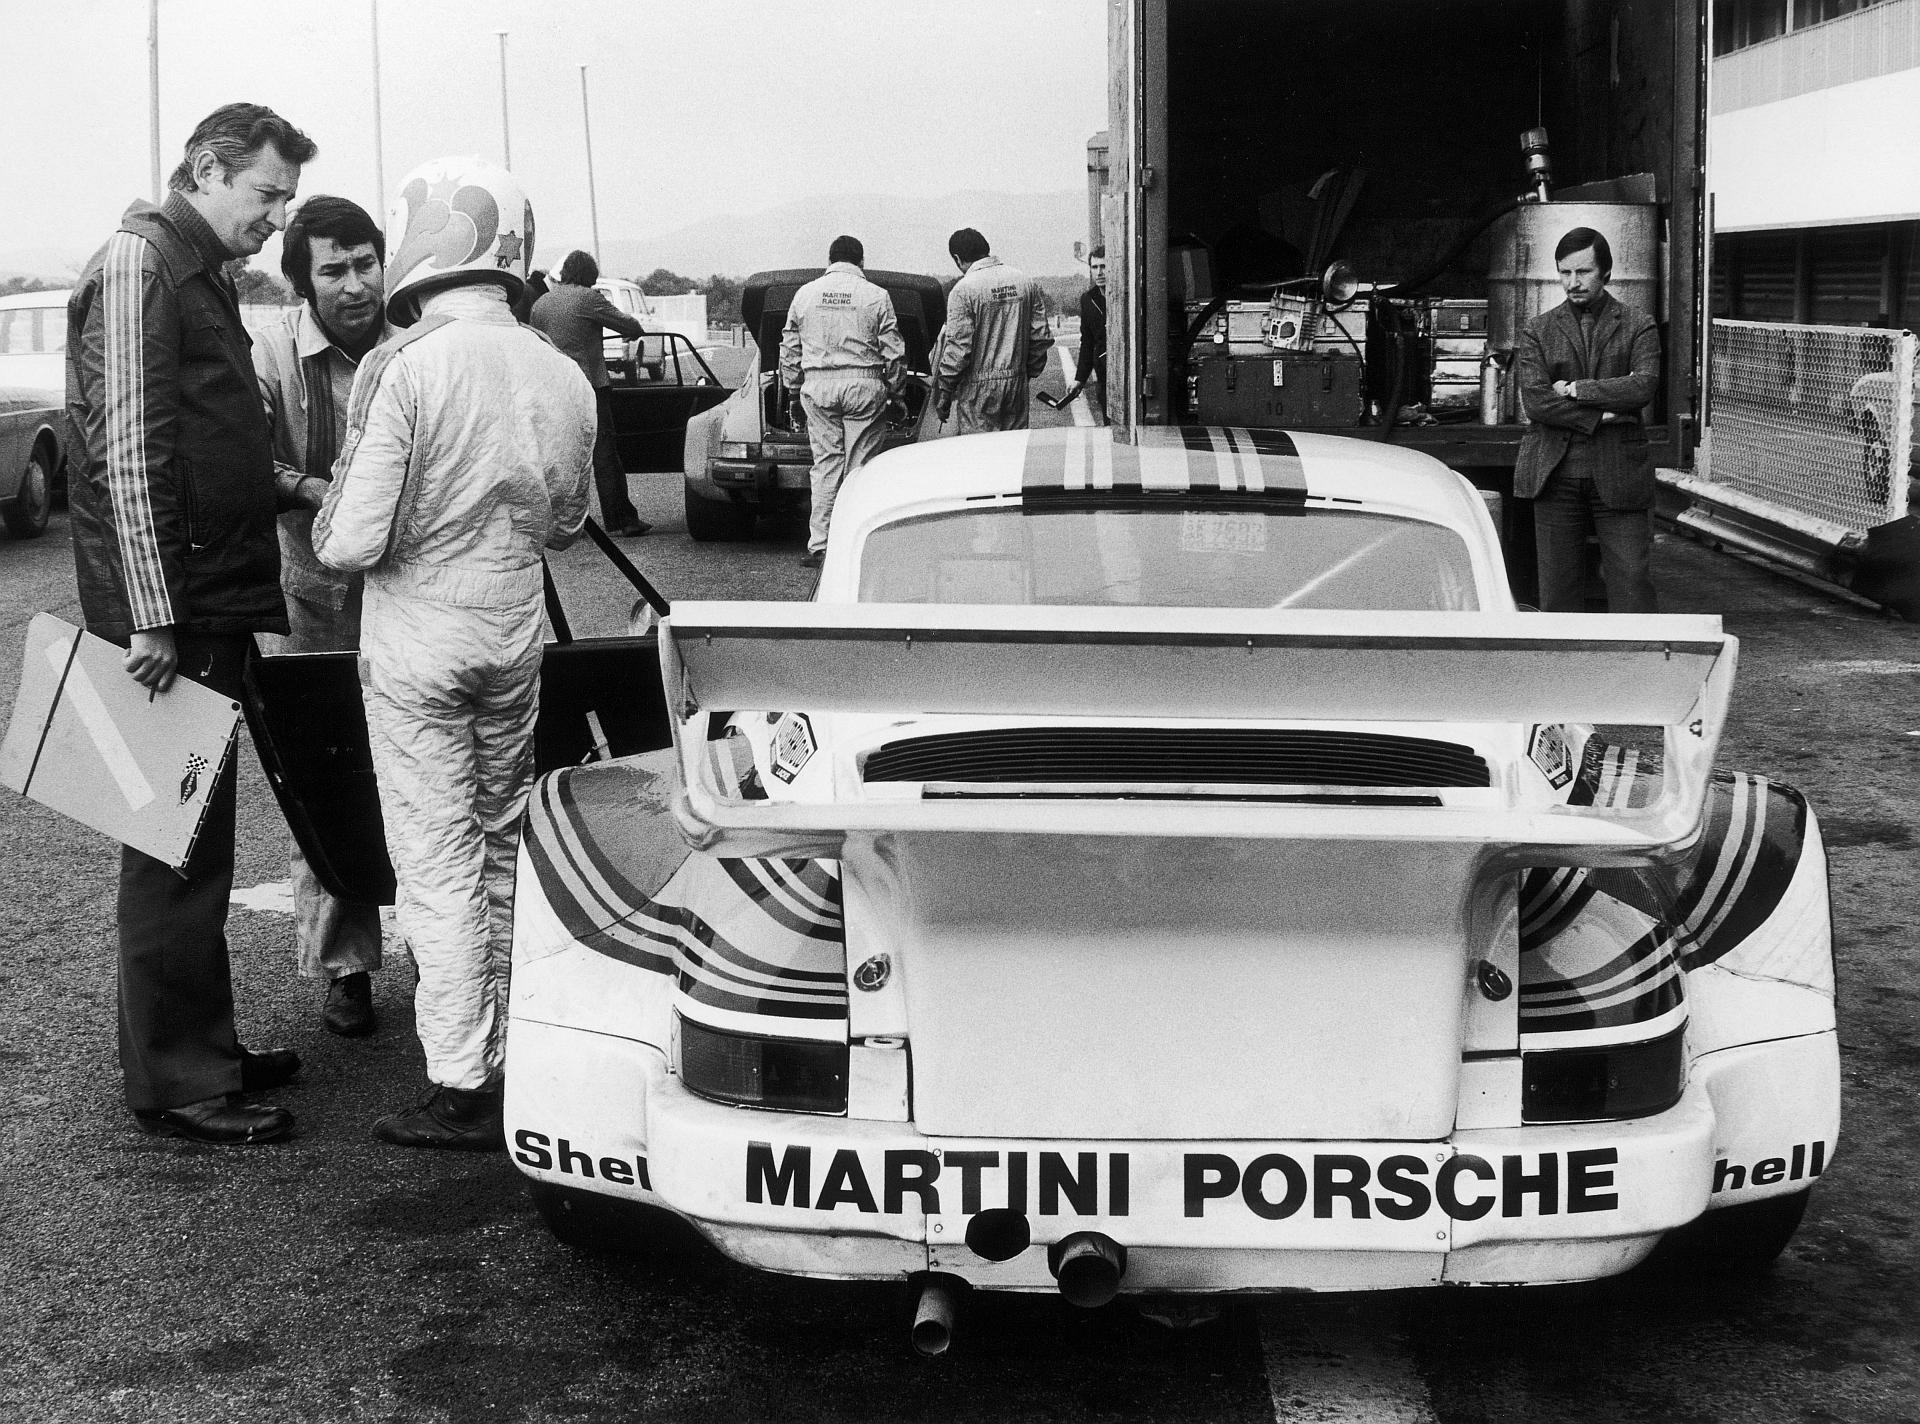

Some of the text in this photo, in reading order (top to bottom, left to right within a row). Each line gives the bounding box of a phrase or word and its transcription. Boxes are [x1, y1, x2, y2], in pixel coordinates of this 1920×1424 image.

[515, 1129, 653, 1191] Shel
[746, 1140, 1130, 1217] MARTINI
[1183, 1147, 1619, 1221] PORSCHE
[1711, 1140, 1825, 1194] hell
